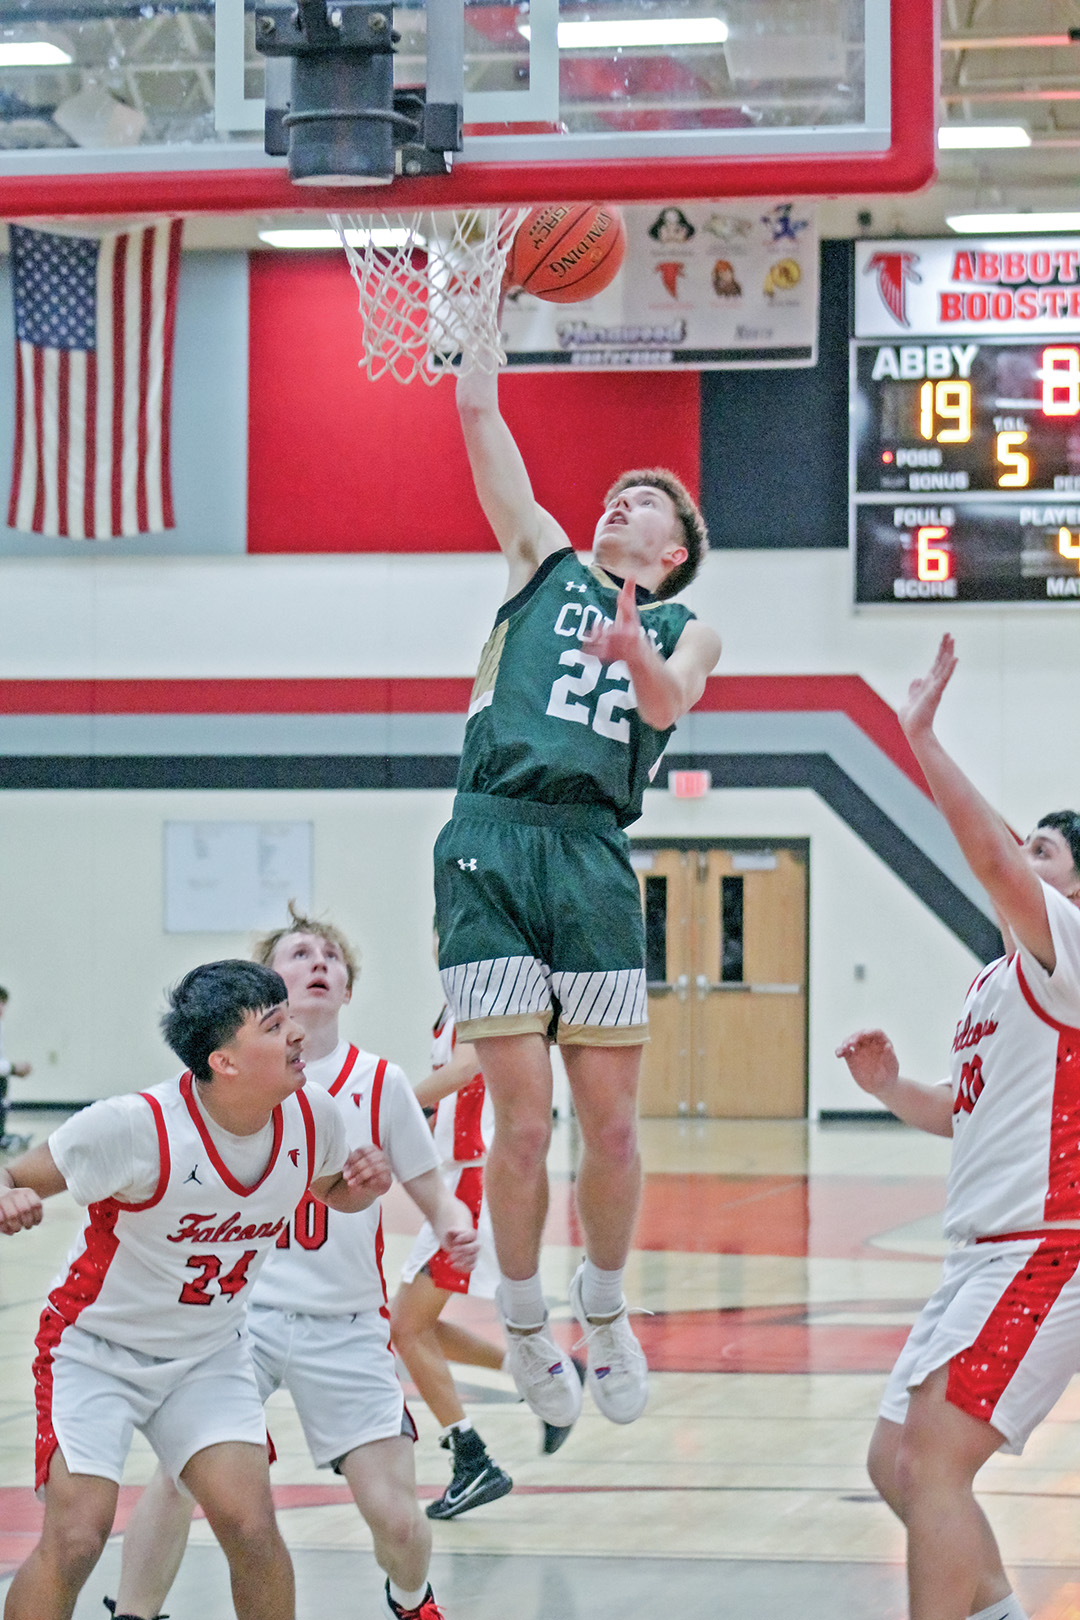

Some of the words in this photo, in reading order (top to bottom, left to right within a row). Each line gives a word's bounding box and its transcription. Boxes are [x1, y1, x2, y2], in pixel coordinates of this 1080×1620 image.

[872, 345, 977, 380] ABBY
[1042, 348, 1080, 416] 8
[920, 381, 971, 443] 19
[909, 472, 968, 490] BONUS
[997, 432, 1028, 487] 5
[894, 507, 955, 526] FOULS
[1020, 507, 1080, 526] PLAYE
[918, 527, 948, 581] 6
[894, 579, 957, 598] SCORE
[546, 649, 638, 744] 22
[167, 1211, 285, 1243] Falcons
[178, 1250, 258, 1306] 24
